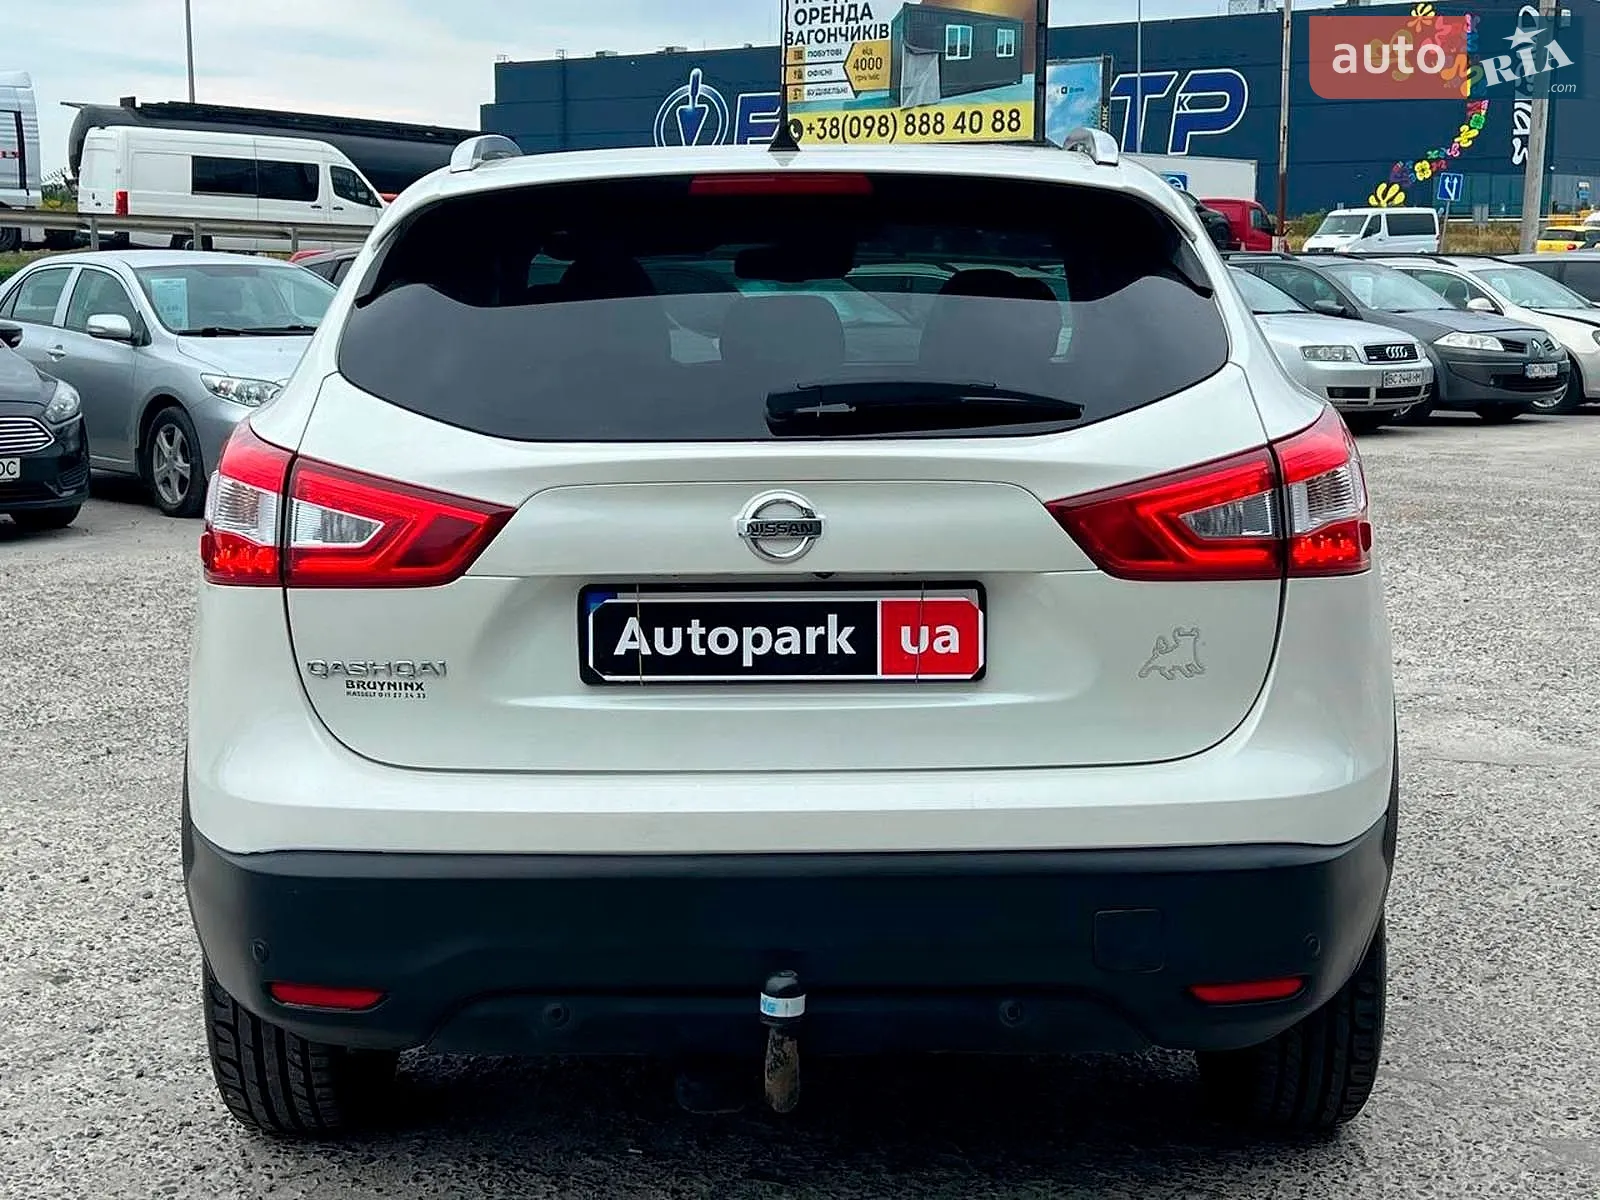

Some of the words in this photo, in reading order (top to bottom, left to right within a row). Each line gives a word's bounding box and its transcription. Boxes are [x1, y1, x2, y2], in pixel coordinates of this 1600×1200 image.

[794, 2, 874, 25] ОРЕНДА
[853, 56, 882, 71] 4000
[806, 112, 898, 144] +38(098)
[903, 112, 945, 137] 888
[952, 110, 984, 134] 40
[991, 108, 1021, 133] 88
[746, 523, 814, 533] NISSAN
[613, 613, 856, 667] Autopark
[900, 623, 960, 655] ua
[307, 659, 447, 679] QASHQAI
[345, 680, 425, 692] BRUYNINX
